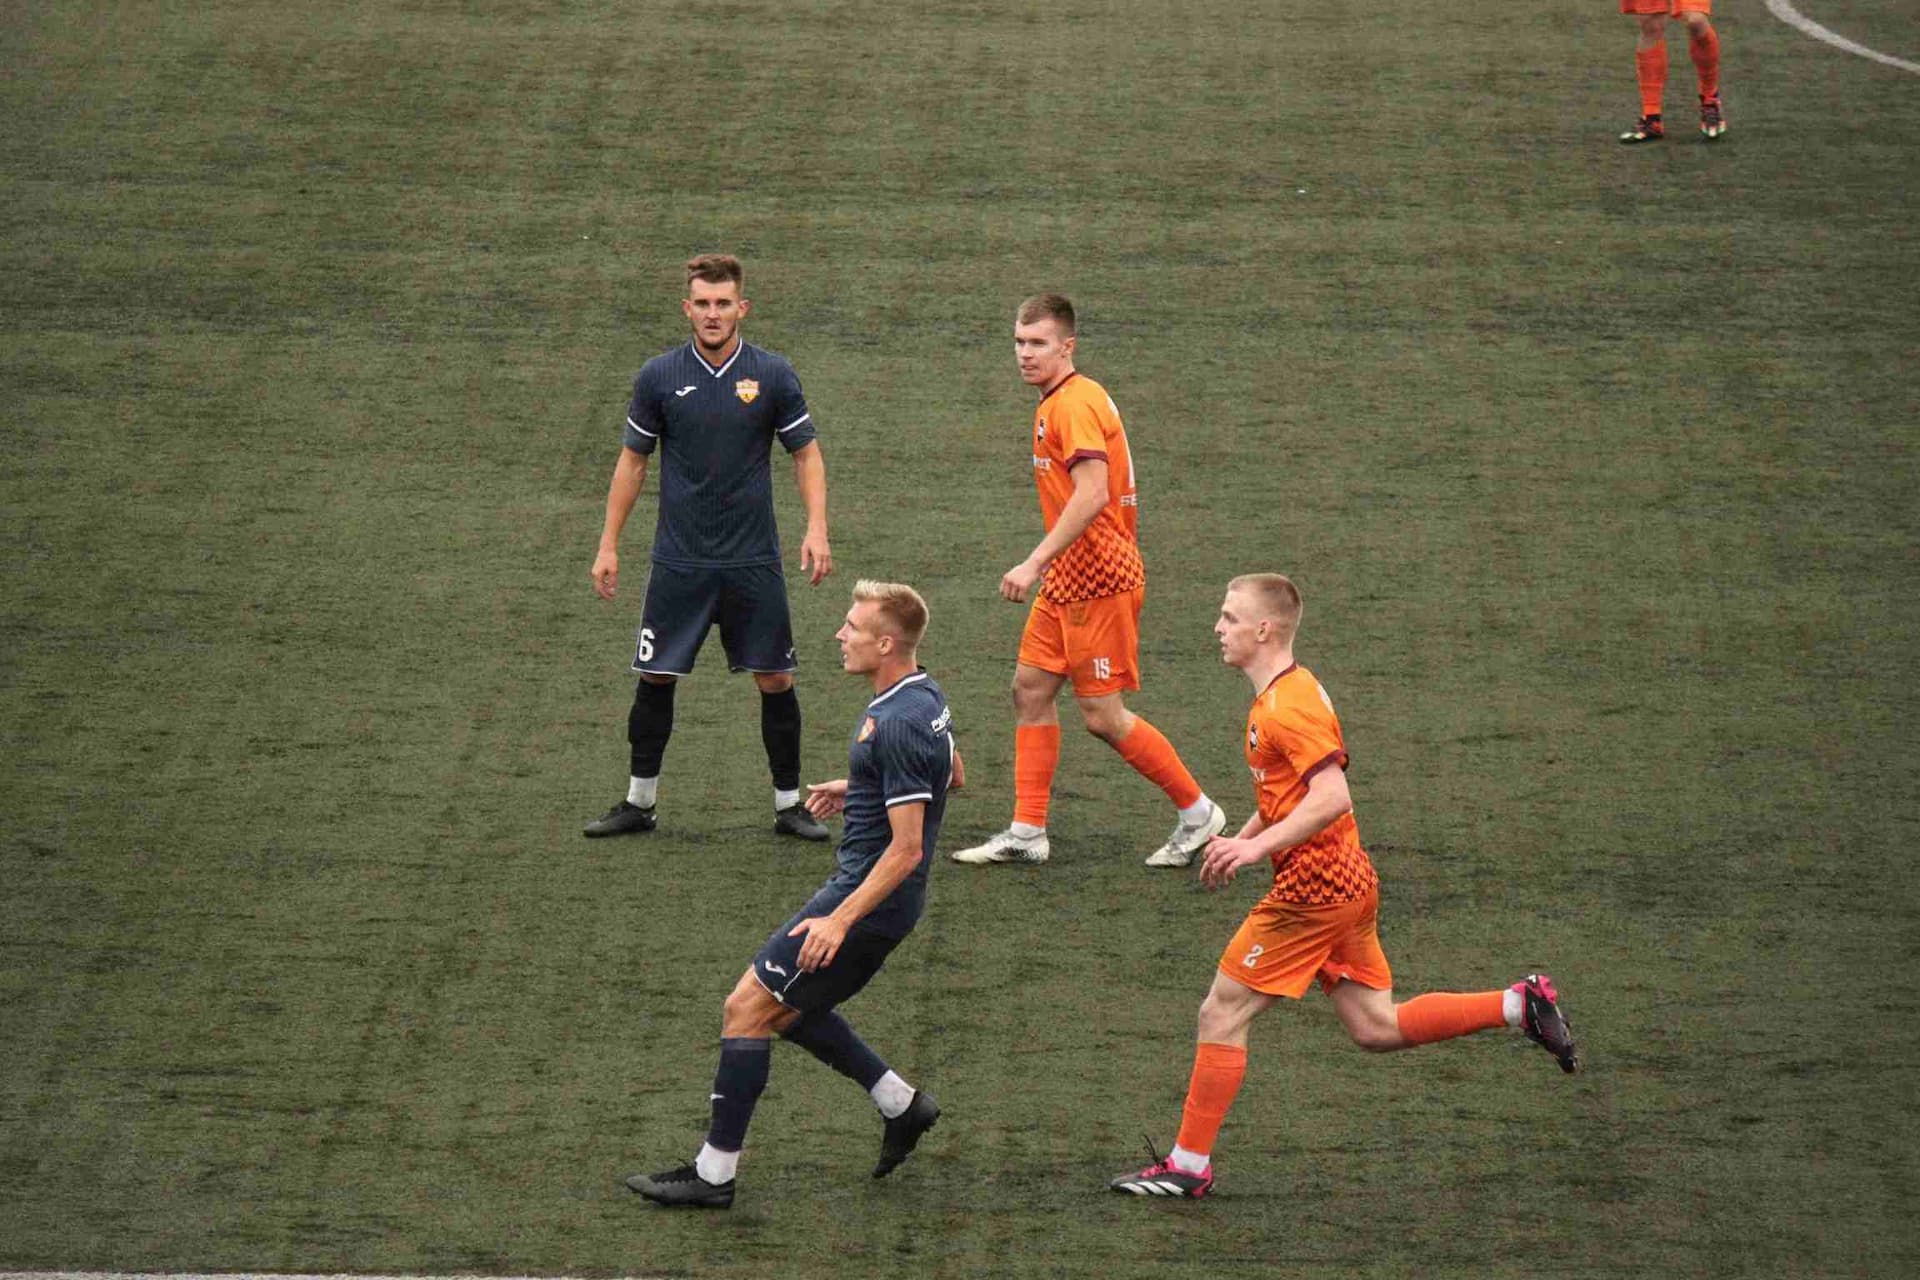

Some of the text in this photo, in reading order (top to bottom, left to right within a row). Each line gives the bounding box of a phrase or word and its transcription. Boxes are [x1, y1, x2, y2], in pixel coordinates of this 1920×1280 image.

[638, 628, 655, 662] 6
[1093, 657, 1110, 680] 15
[1242, 944, 1264, 968] 2
